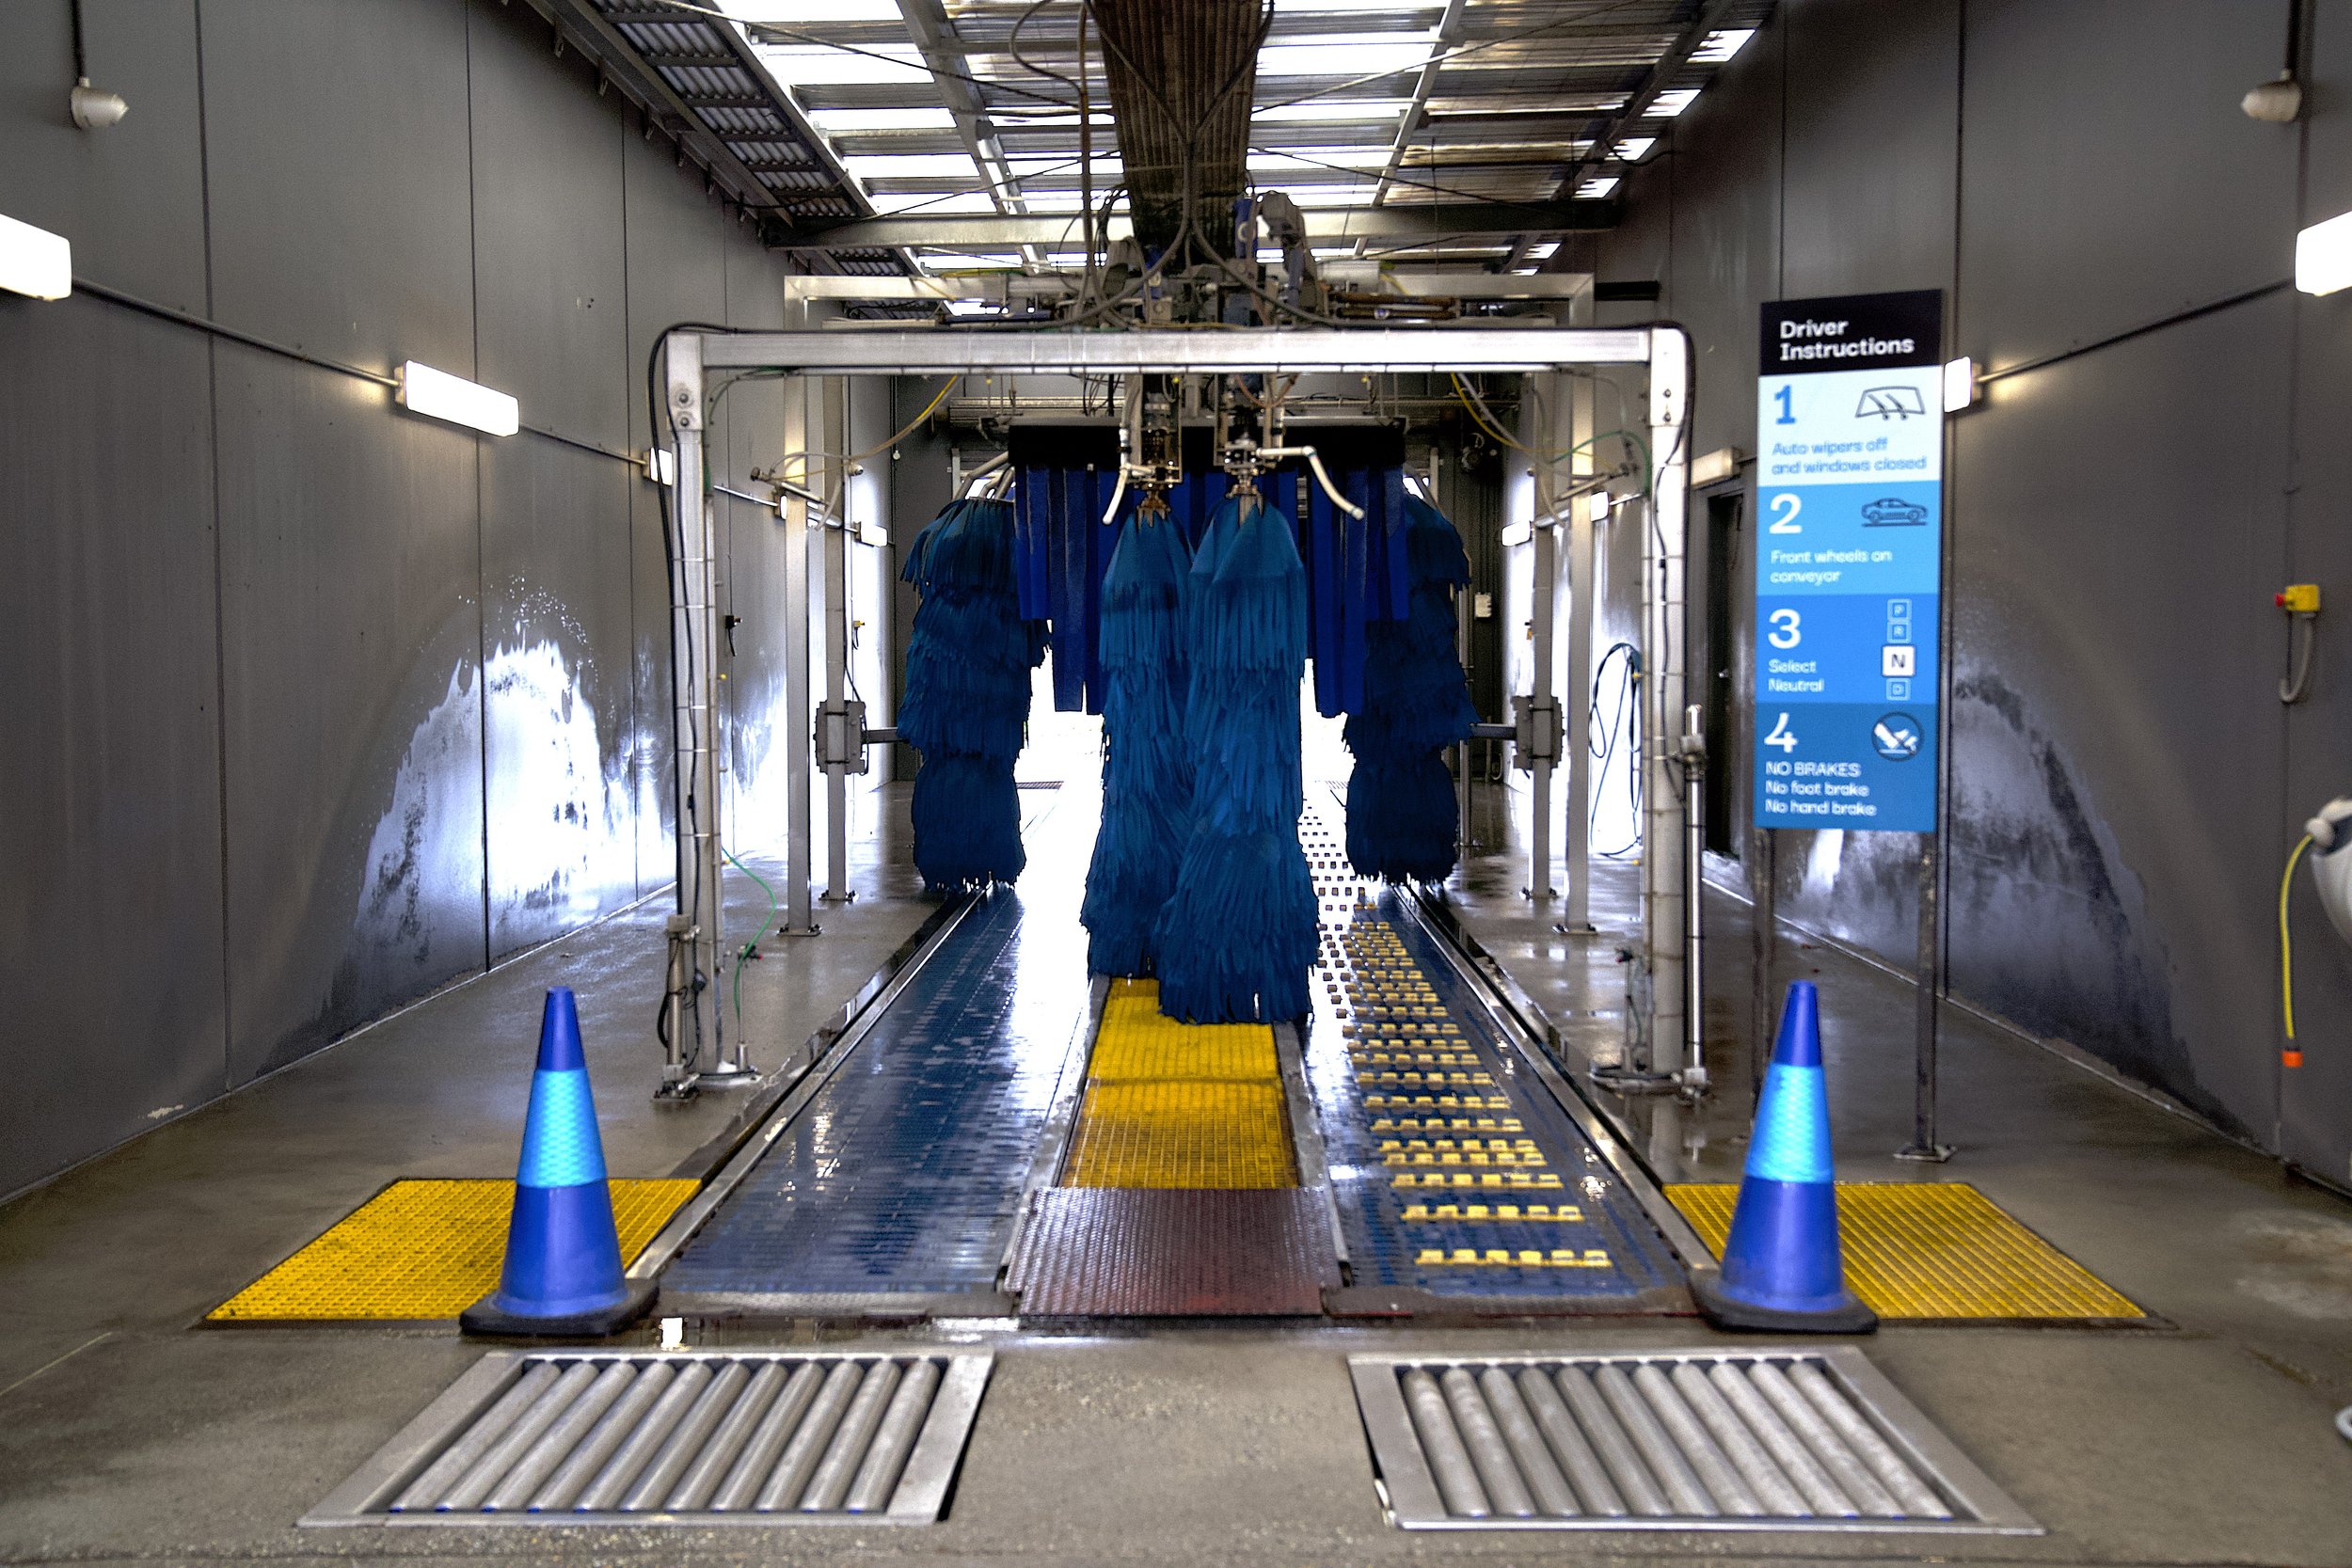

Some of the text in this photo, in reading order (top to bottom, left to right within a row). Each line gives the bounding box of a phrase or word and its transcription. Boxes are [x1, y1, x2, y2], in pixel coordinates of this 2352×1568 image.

[1780, 319, 1849, 339] Driver
[1780, 337, 1915, 361] Instructions
[1774, 384, 1796, 424] 1
[1772, 437, 1888, 457] Auto wipers off
[1772, 456, 1927, 475] and windows closed
[1769, 493, 1803, 534] 2
[1771, 548, 1893, 564] Front wheels on
[1770, 571, 1842, 586] conveyor
[1768, 609, 1801, 649] 3
[1769, 658, 1817, 673] Select
[1891, 654, 1906, 669] N
[1769, 678, 1825, 692] Neutral
[1764, 712, 1798, 752] 4
[1766, 762, 1862, 777] NO BRAKES
[1766, 781, 1869, 798] No foot brake
[1765, 800, 1877, 816] No hand brake
